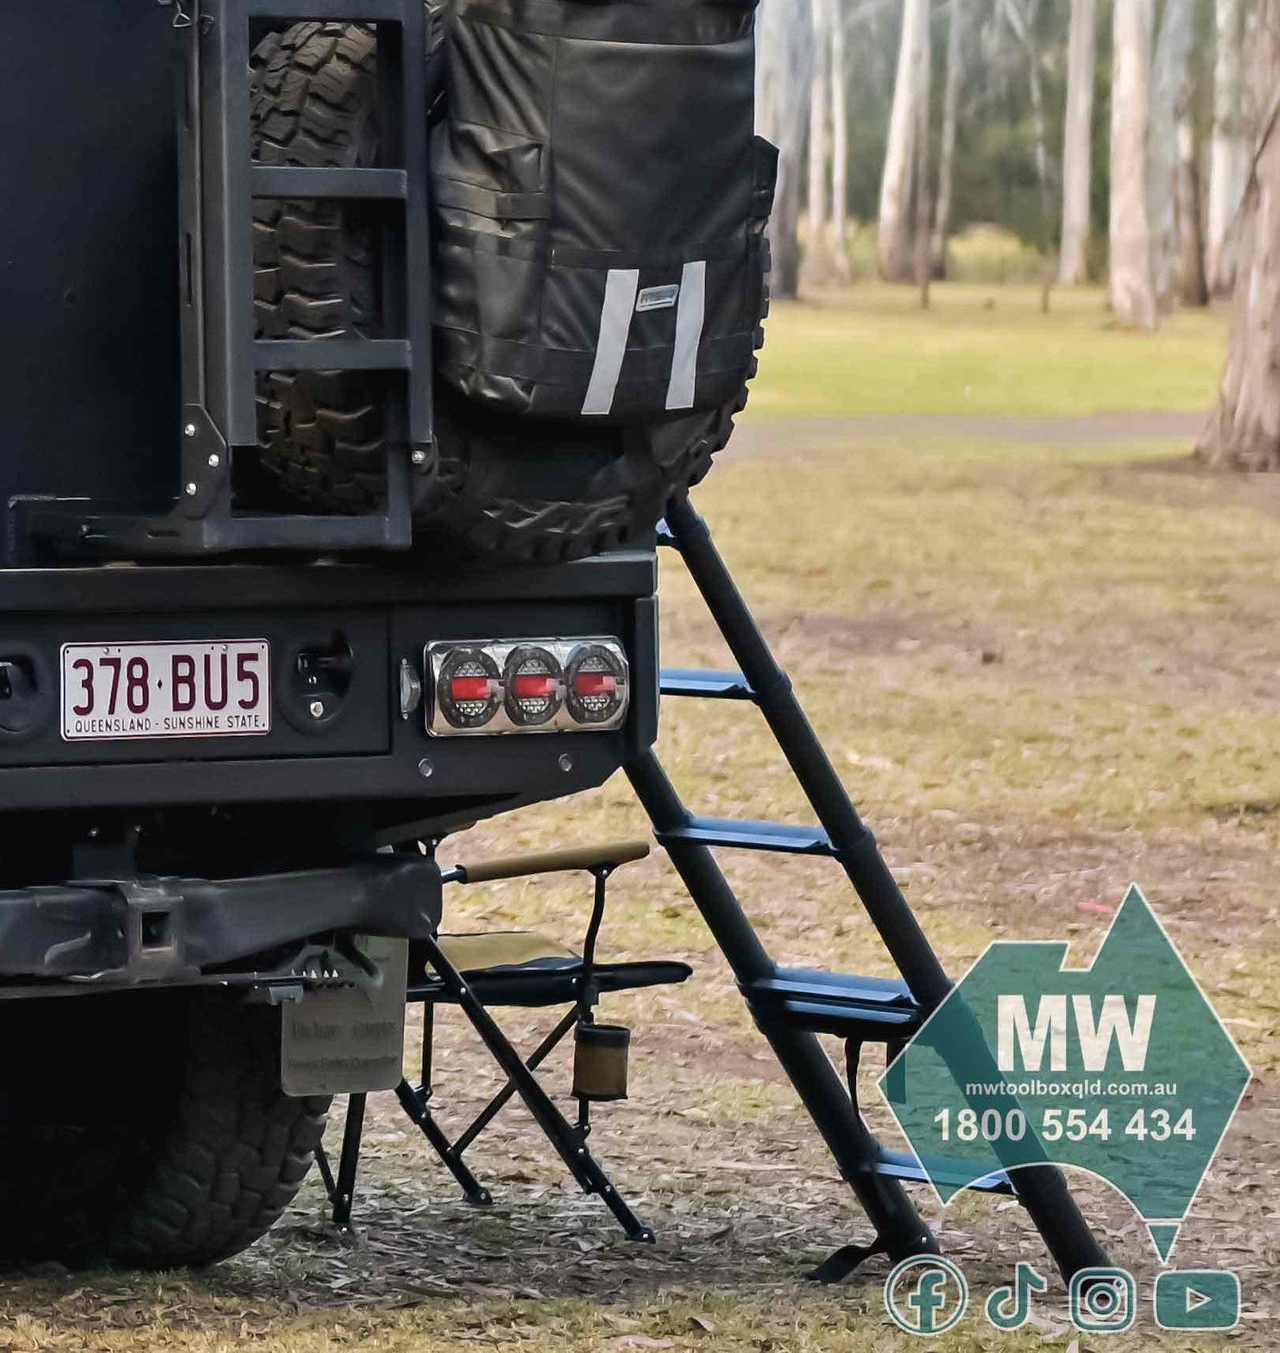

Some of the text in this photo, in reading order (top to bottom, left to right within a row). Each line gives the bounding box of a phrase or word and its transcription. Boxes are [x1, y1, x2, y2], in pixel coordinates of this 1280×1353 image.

[72, 653, 259, 716] 378 BU5
[75, 714, 260, 733] QUEENSLAND SUNSHINE STATE
